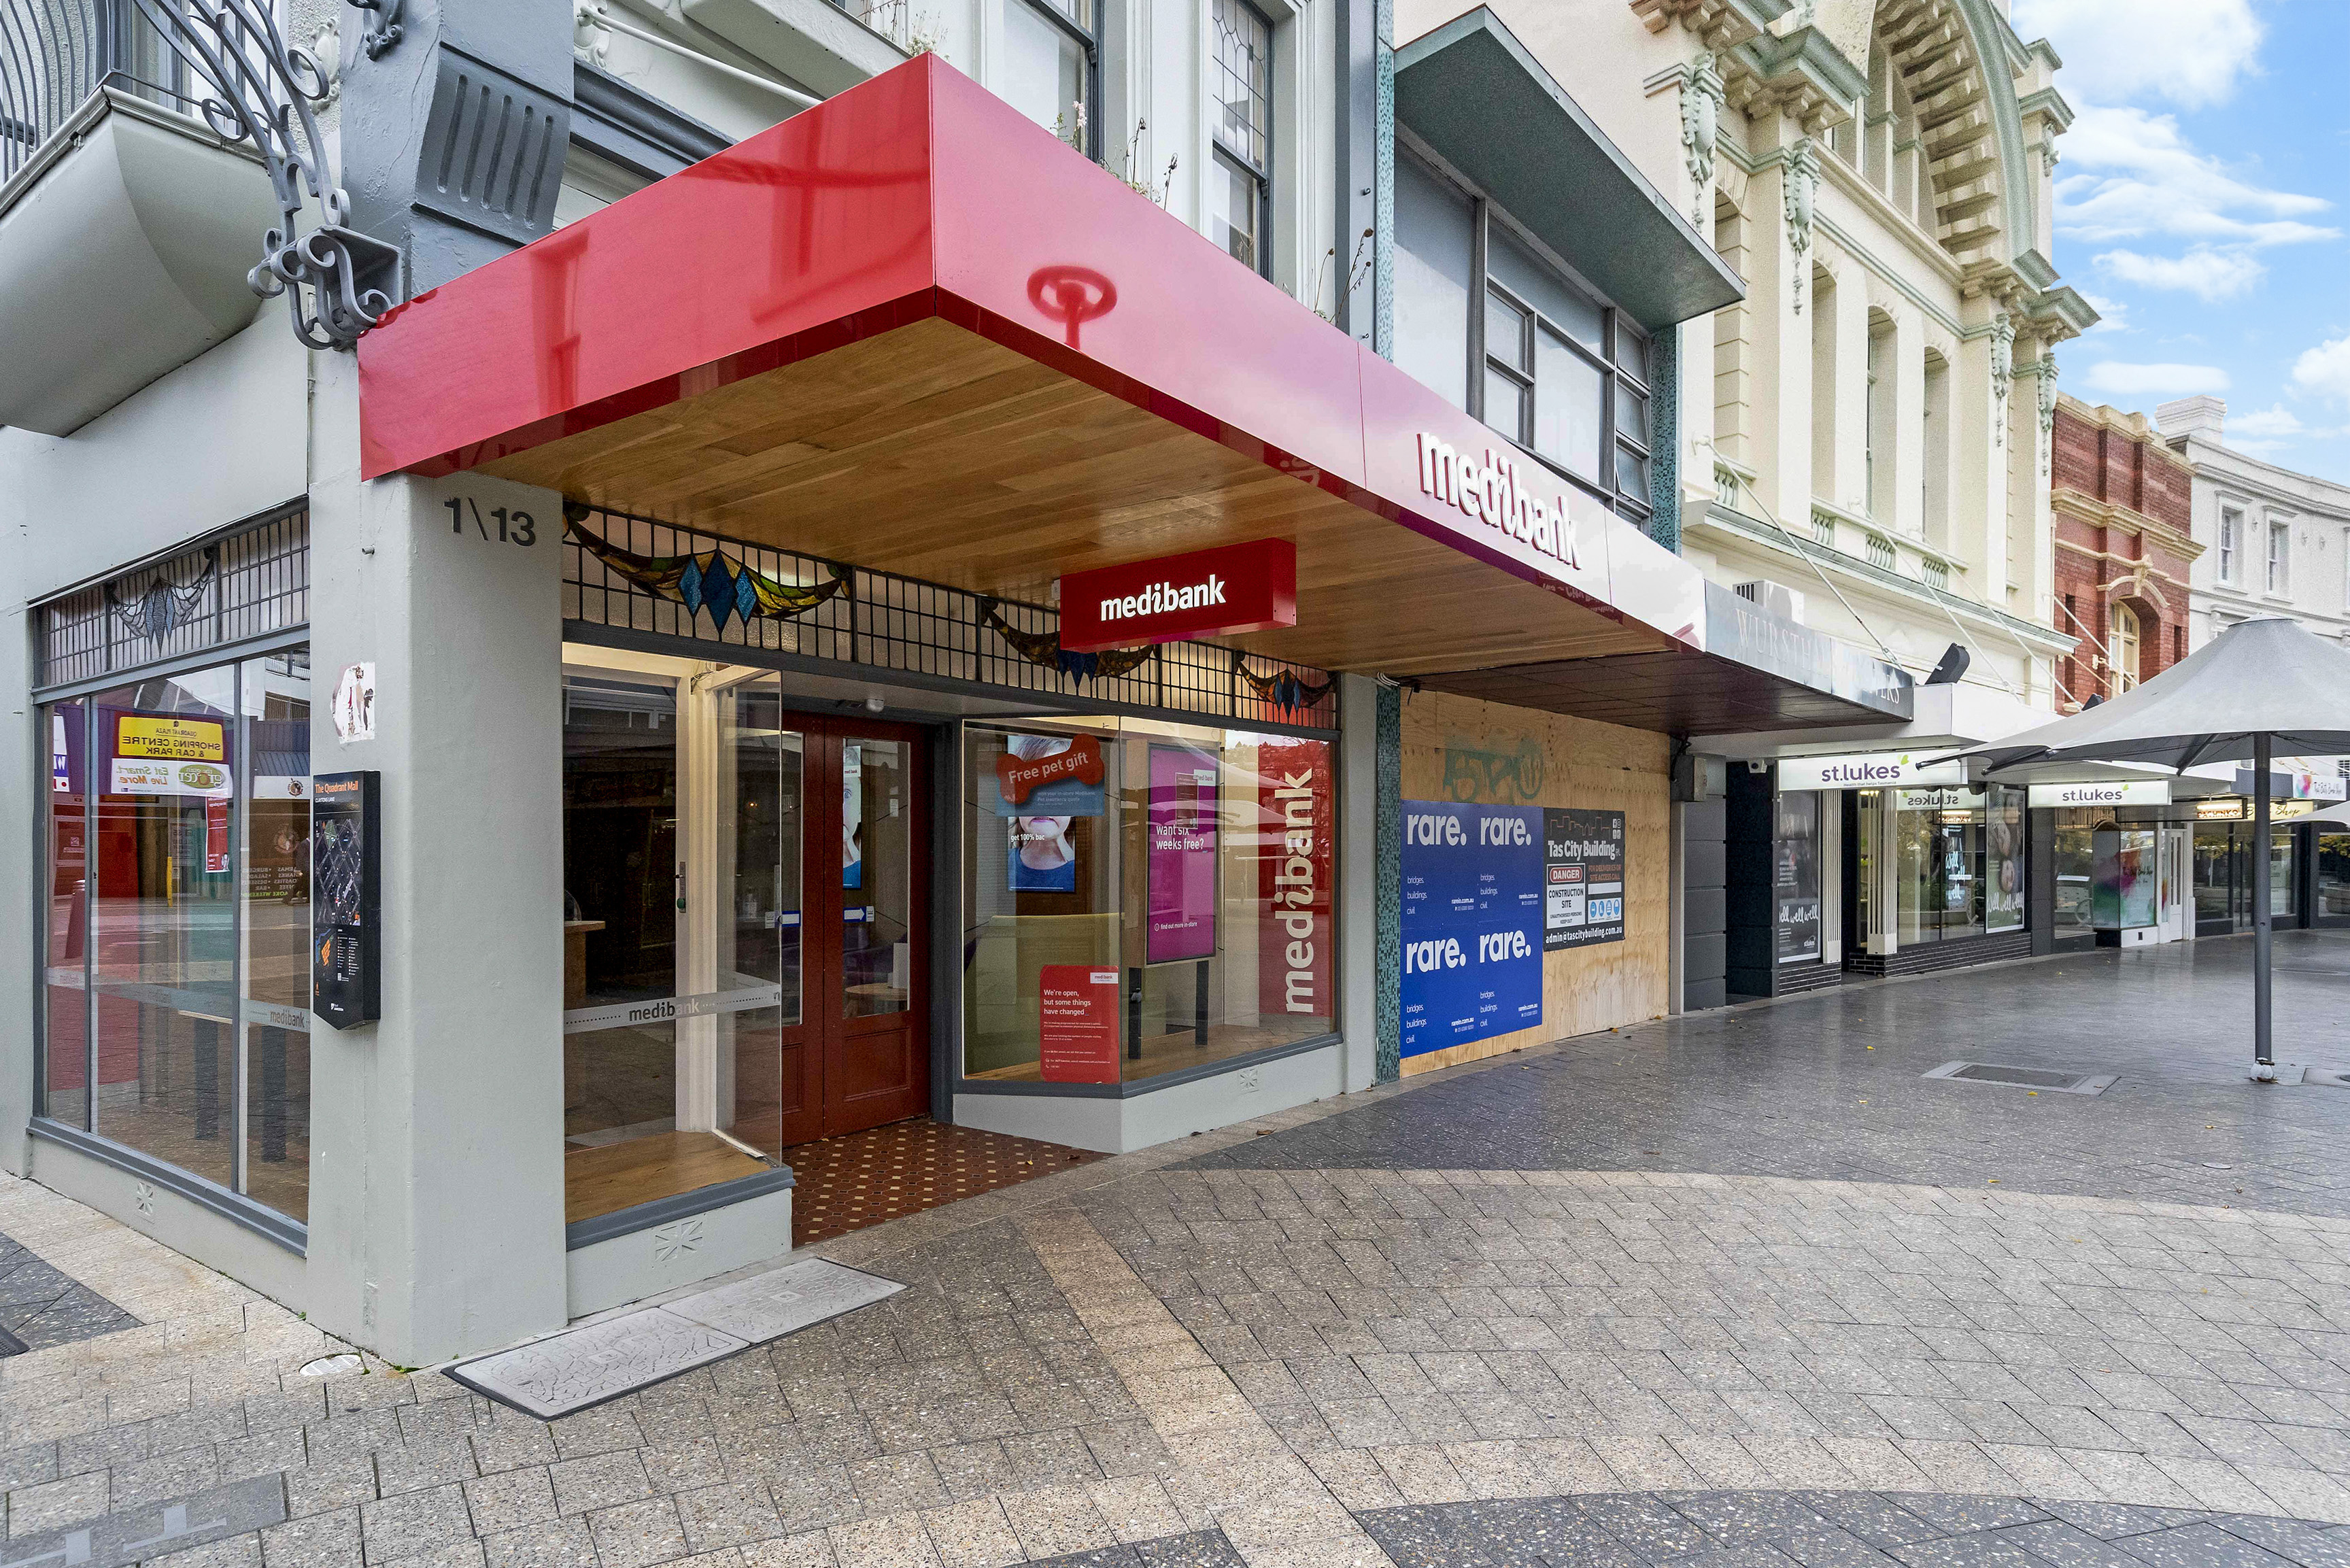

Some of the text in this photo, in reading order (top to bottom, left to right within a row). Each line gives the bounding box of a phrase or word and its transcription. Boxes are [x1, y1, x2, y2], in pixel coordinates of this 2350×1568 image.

[1416, 432, 1582, 570] medibank
[1101, 574, 1226, 621] medibank
[1008, 752, 1089, 783] Free pet gift
[1822, 763, 1901, 782] st.lukes
[315, 780, 359, 794] The Quadrant Mall
[2062, 789, 2122, 801] st.lukes
[2277, 806, 2300, 817] Shop
[1156, 824, 1176, 835] want
[1407, 814, 1467, 846] rare.
[1480, 817, 1531, 846] rare.
[1156, 838, 1204, 850] weeks free?
[1548, 840, 1563, 857] Tas
[1564, 840, 1582, 861] City
[1583, 840, 1616, 860] Building
[1553, 870, 1580, 879] DANGER
[1275, 768, 1314, 1012] medibank
[1548, 888, 1584, 898] CONSTRUCTION
[1561, 900, 1571, 908] SITE
[1790, 906, 1804, 923] well
[1804, 904, 1818, 921] well
[1546, 926, 1622, 944] admin@tascitybuilding.com.au
[1406, 938, 1467, 974] rare.
[1479, 930, 1531, 964] rare.
[270, 1010, 305, 1027] medibank
[629, 998, 700, 1021] medibank
